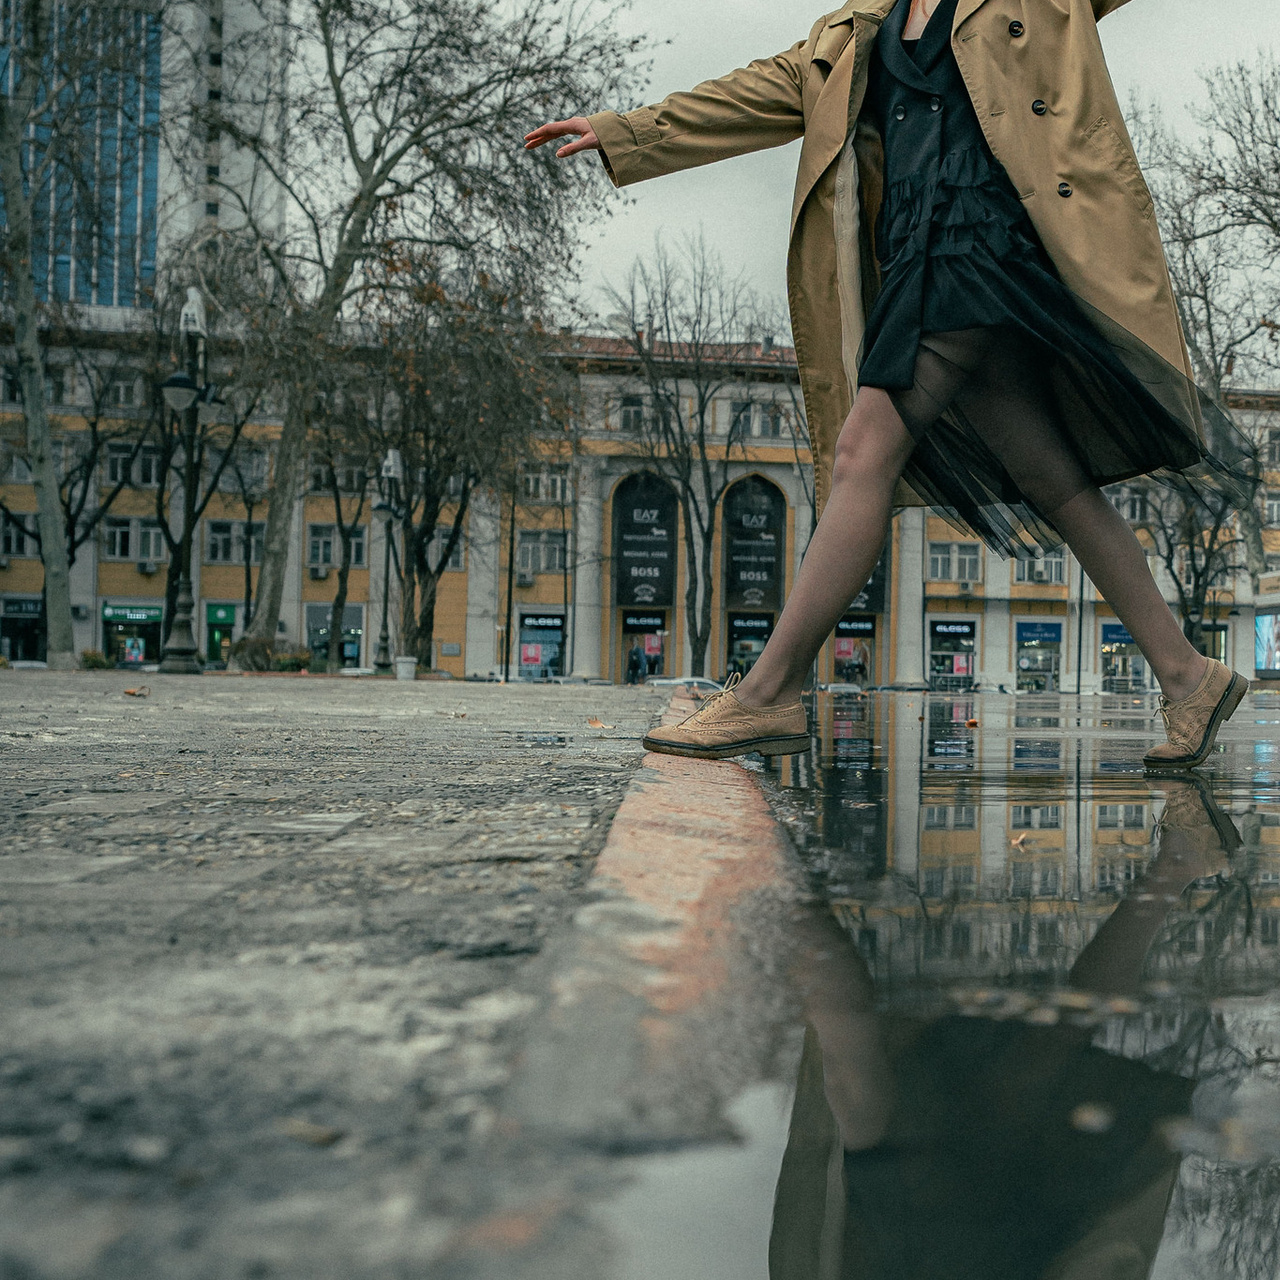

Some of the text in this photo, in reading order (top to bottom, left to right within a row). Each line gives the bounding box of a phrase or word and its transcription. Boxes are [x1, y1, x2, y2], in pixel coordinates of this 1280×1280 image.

[633, 508, 659, 521] EA7
[741, 513, 767, 526] EA7
[630, 566, 660, 578] BOSS
[740, 570, 768, 582] BOSS
